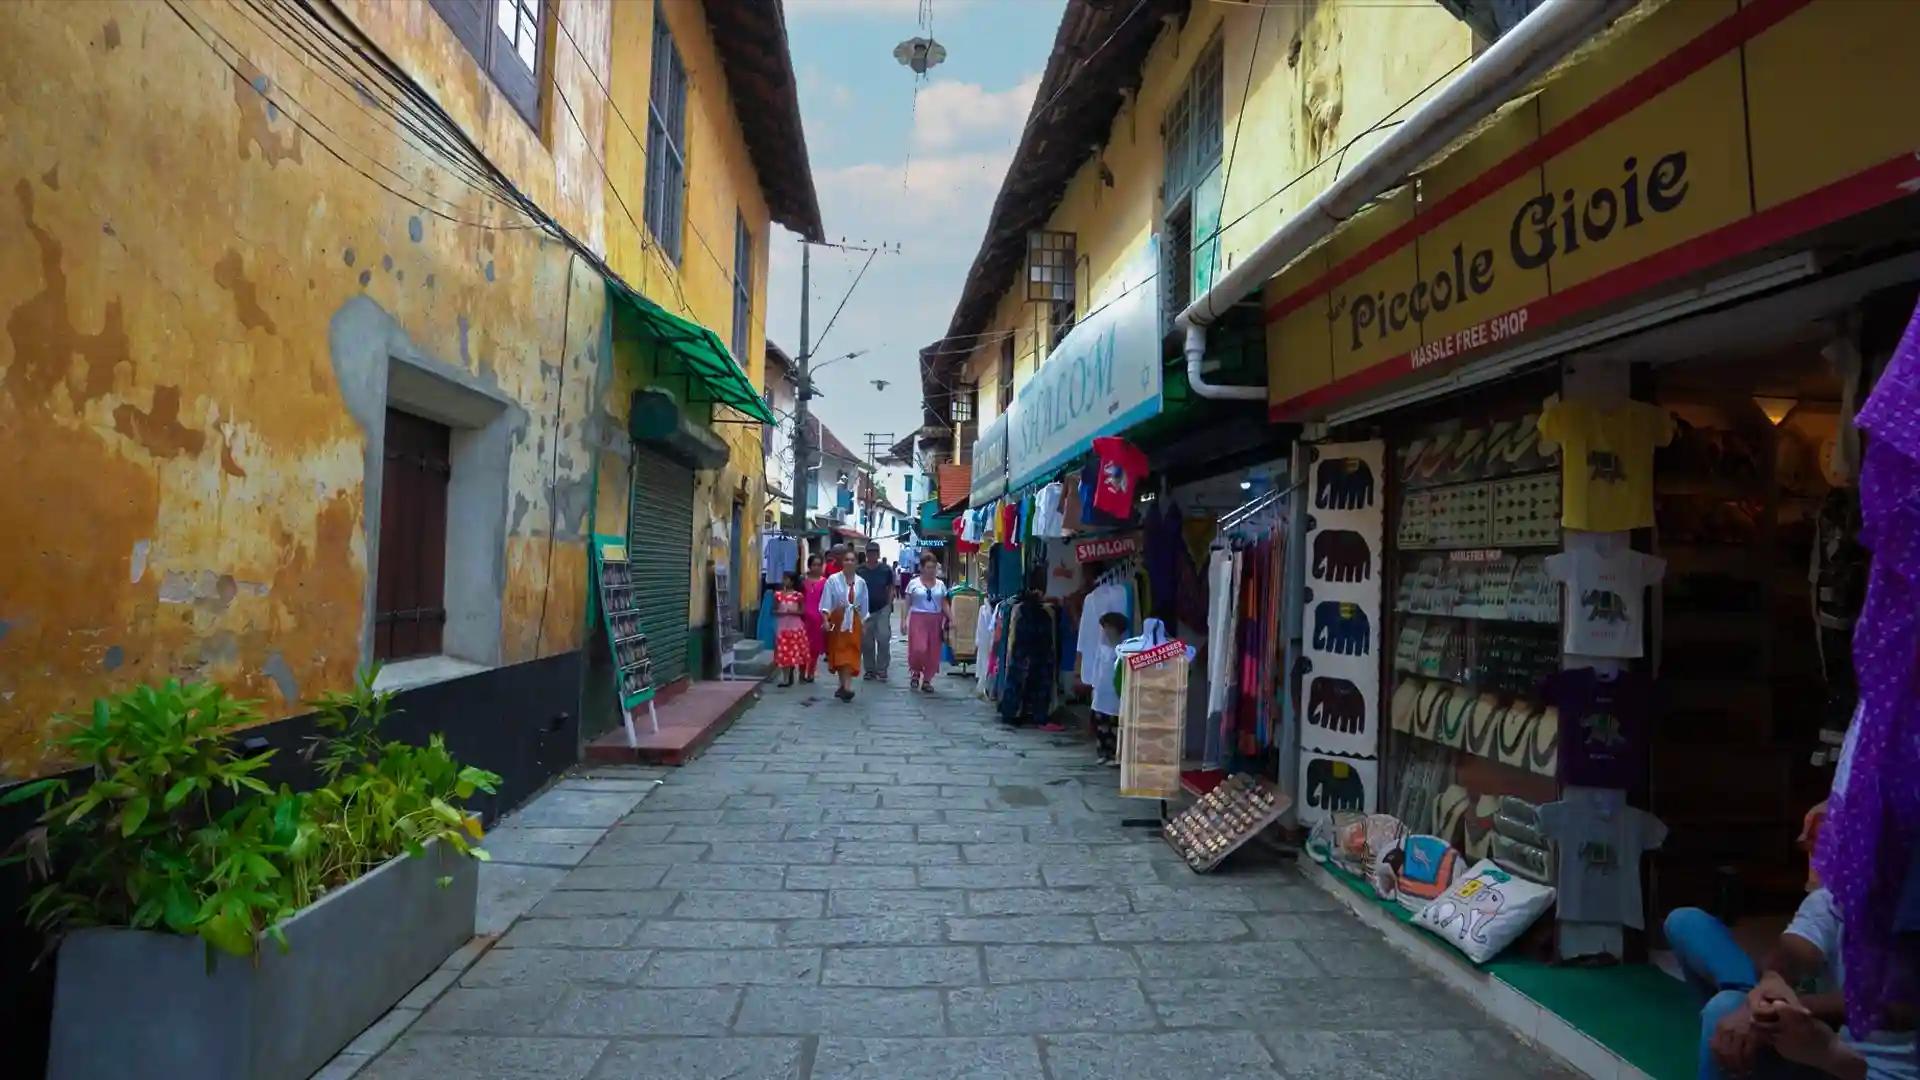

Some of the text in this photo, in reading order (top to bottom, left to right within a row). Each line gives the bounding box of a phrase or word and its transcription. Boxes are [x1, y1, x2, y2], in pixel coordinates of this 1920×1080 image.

[1350, 241, 1495, 352] Piccole
[1509, 149, 1690, 271] Gioie
[1410, 308, 1528, 369] HASSLE FREE SHOP
[1020, 320, 1117, 461] SHALOM
[1078, 539, 1136, 559] SHALOM
[1130, 650, 1157, 665] KERALA
